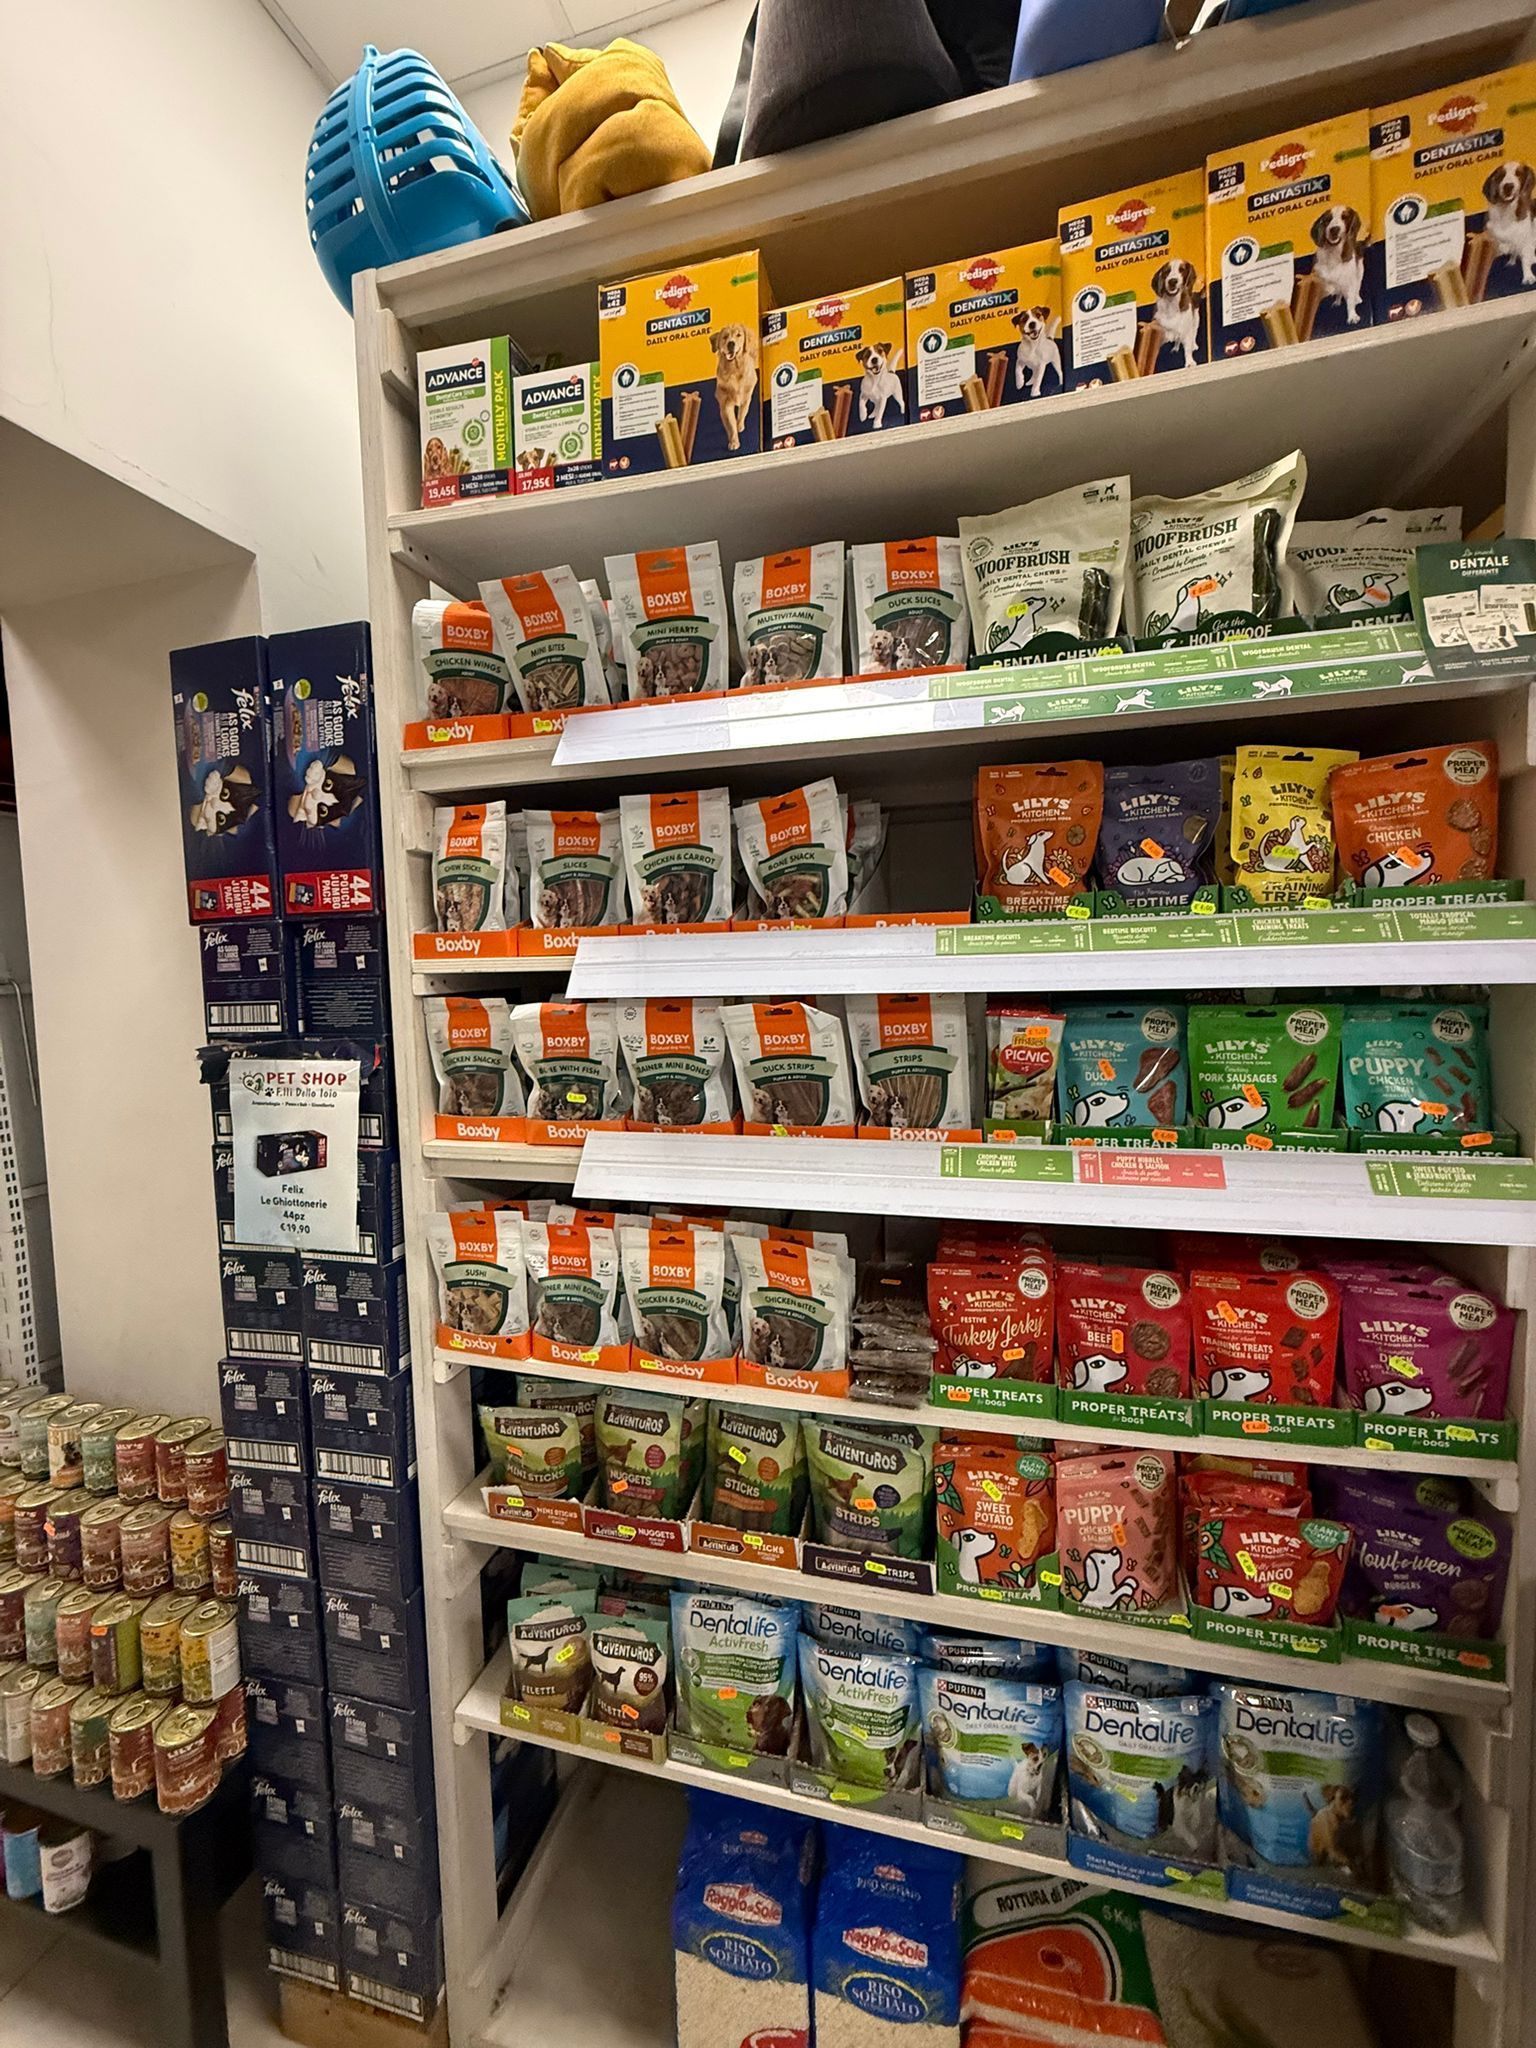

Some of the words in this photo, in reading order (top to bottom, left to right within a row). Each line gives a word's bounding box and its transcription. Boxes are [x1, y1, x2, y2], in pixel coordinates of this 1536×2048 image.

[1107, 205, 1156, 224] Pedigree
[1100, 233, 1164, 257] DENTASTIX
[959, 264, 1005, 281] Pedigree
[655, 282, 699, 300] Pedigree
[808, 301, 850, 318] Pedigree
[954, 293, 1012, 313] DENTASTIX
[650, 310, 707, 333] DENTASTIX
[950, 319, 971, 328] DAILY
[974, 314, 994, 323] ORAL
[996, 308, 1019, 318] CARE
[646, 337, 667, 345] DAILY
[669, 333, 689, 342] ORAL
[691, 328, 710, 337] CARE
[803, 328, 858, 349] DENTASTIX
[428, 367, 483, 387] ADVANCE
[494, 370, 504, 401] PACK
[525, 384, 582, 405] ADVANCE
[496, 404, 506, 461] MONTHLY
[428, 485, 456, 498] 19,45€
[522, 477, 550, 490] 17,95€
[1134, 518, 1238, 561] WOOFBRUSH
[974, 551, 1070, 581] WOOFBRUSH
[1450, 556, 1509, 570] DENTALE
[891, 570, 934, 580] BOXBY
[889, 596, 913, 608] DUCK
[914, 595, 941, 607] SLICES
[757, 611, 814, 625] MULTIVITAMIN
[647, 626, 665, 637] MINI
[668, 626, 699, 636] HEARTS
[434, 658, 471, 668] CHICKEN
[473, 660, 501, 673] WINGS
[333, 714, 344, 746] GOOD
[1448, 760, 1486, 768] PROPER
[1454, 766, 1480, 774] MEAT
[1012, 797, 1071, 813] LILY'S
[1120, 794, 1181, 811] LILY'S
[1130, 806, 1170, 815] KITCHEN
[1355, 791, 1426, 814] LILY'S
[1022, 809, 1060, 818] KITCHEN
[558, 836, 596, 846] BOXBY
[1366, 828, 1422, 842] CHICKEN
[563, 861, 588, 869] SLICES
[644, 855, 675, 872] CHICKEN
[683, 853, 716, 865] CARROT
[767, 859, 786, 871] BONE
[790, 852, 815, 862] SNACK
[224, 886, 234, 910] PACK
[232, 880, 243, 914] JUMBO
[241, 880, 251, 913] POUCH
[250, 881, 270, 914] 44
[322, 880, 331, 904] PACK
[330, 874, 340, 910] JUMBO
[340, 874, 350, 908] POUCH
[350, 875, 370, 909] 44
[1007, 896, 1069, 905] BREAKTIME
[435, 937, 481, 954] Boxby
[1290, 1016, 1326, 1029] PROPER
[452, 1028, 487, 1039] BOXBY
[650, 1033, 689, 1045] BOXBY
[1295, 1026, 1319, 1036] MEAT
[547, 1037, 586, 1047] BOXBY
[473, 1054, 501, 1065] SNACKS
[894, 1054, 923, 1063] STRIPS
[1005, 1050, 1049, 1064] PICNIC
[560, 1066, 579, 1074] WITH
[582, 1066, 600, 1076] FISH
[665, 1062, 684, 1071] MINI
[686, 1063, 712, 1077] BONES
[762, 1064, 785, 1073] DUCK
[787, 1062, 815, 1072] STRIPS
[1349, 1057, 1424, 1076] PUPPY
[267, 1072, 295, 1083] PET
[301, 1072, 347, 1085] SHOP
[1199, 1073, 1224, 1083] PORK
[1226, 1073, 1277, 1083] SAUSAGES
[296, 1087, 317, 1098] Dello
[457, 1123, 500, 1140] Boxby
[282, 1184, 304, 1194] Felix
[261, 1196, 271, 1205] Le
[273, 1197, 328, 1209] Ghiottonerie
[283, 1211, 305, 1220] 44pz
[459, 1242, 494, 1253] BOXBY
[552, 1255, 587, 1266] BOXBY
[465, 1269, 487, 1277] SUSHI
[563, 1282, 581, 1291] MINI
[637, 1294, 669, 1305] CHICKEN
[676, 1296, 708, 1312] SPINACH
[1295, 1298, 1320, 1311] MEAT
[960, 1316, 987, 1324] FESTIVE
[1081, 1308, 1117, 1319] KITCHEN
[1459, 1312, 1486, 1324] MEAT
[944, 1324, 999, 1350] Turkey
[1000, 1312, 1045, 1347] Jerky
[1087, 1331, 1112, 1343] BEEF
[1201, 1336, 1241, 1352] TRAINING
[1242, 1343, 1273, 1354] TREATS
[655, 1359, 704, 1379] Boxby
[765, 1371, 818, 1393] Boxby
[985, 1399, 1006, 1407] DOGS
[1072, 1400, 1126, 1415] PROPER
[1130, 1406, 1185, 1422] TREATS
[1122, 1416, 1144, 1425] DOGS
[1212, 1410, 1270, 1424] PROPER
[1276, 1415, 1336, 1429] TREATS
[1364, 1423, 1428, 1439] PROPER
[1423, 1440, 1450, 1448] DOGS
[724, 1478, 759, 1497] STICKS
[976, 1501, 1011, 1515] SWEET
[1064, 1505, 1126, 1524] PUPPY
[836, 1507, 880, 1528] STRIPS
[974, 1511, 1014, 1525] POTATO
[638, 1528, 675, 1540] NUGGETS
[1245, 1569, 1293, 1584] MANGO
[708, 1635, 769, 1652] ActivFresh
[837, 1684, 898, 1704] ActivFresh
[948, 1682, 985, 1698] PURINA
[705, 1889, 746, 1914] Raggio
[755, 1904, 781, 1920] Sole
[996, 1883, 1050, 1913] ROTTURA
[723, 1939, 756, 1959] RISO
[844, 1928, 890, 1952] Raggio
[897, 1945, 926, 1962] Sole
[709, 1948, 772, 1974] SOFFIATO
[868, 1979, 902, 2000] RISO
[852, 1988, 922, 2017] SOFFIATO
